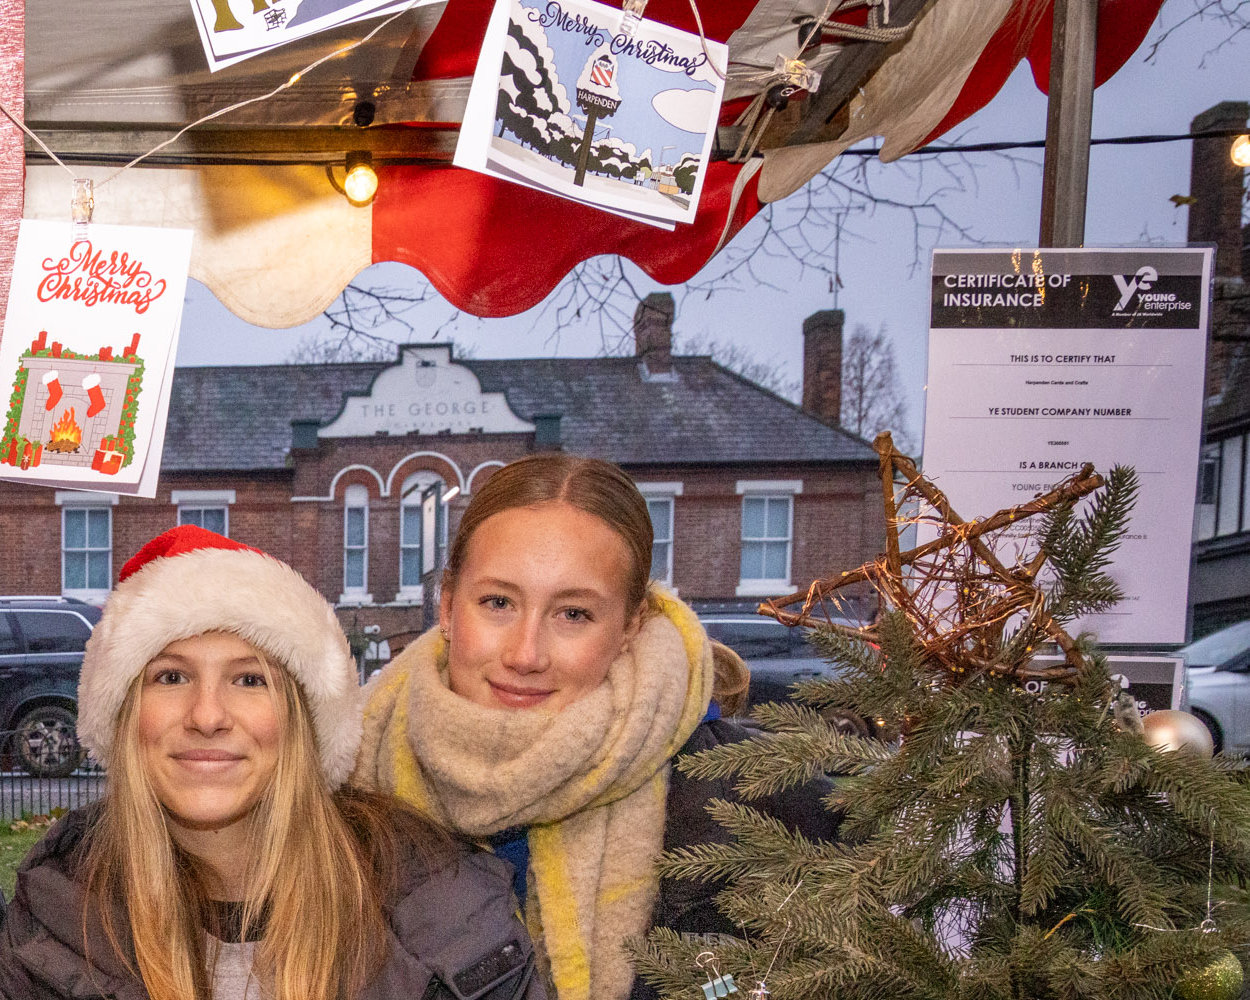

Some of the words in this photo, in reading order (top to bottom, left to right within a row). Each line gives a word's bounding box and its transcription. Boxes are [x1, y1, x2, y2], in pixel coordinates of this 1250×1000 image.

[527, 2, 604, 47] Merry
[610, 34, 707, 75] Christmas
[577, 90, 618, 109] HARPENDEN
[42, 240, 152, 288] Merry
[943, 274, 1043, 288] CERTIFICATE
[1049, 274, 1071, 288] OF
[37, 272, 167, 314] Christmas
[943, 293, 1043, 307] INSURANCE
[1144, 301, 1191, 311] enterprise
[1010, 354, 1029, 363] THIS
[1031, 354, 1039, 363] IS
[1041, 354, 1053, 363] TO
[1056, 355, 1091, 363] CERTIFY
[1093, 355, 1115, 363] THAT
[361, 402, 396, 417] THE
[408, 401, 489, 416] GEORGE
[989, 407, 1000, 416] YE
[1001, 407, 1039, 416] STUDENT
[1042, 408, 1091, 416] COMPANY
[1093, 408, 1131, 416] NUMBER
[1019, 461, 1028, 470] IS
[1029, 461, 1037, 470] A
[1039, 461, 1078, 470] BRANCH
[1012, 483, 1041, 491] YOUNG
